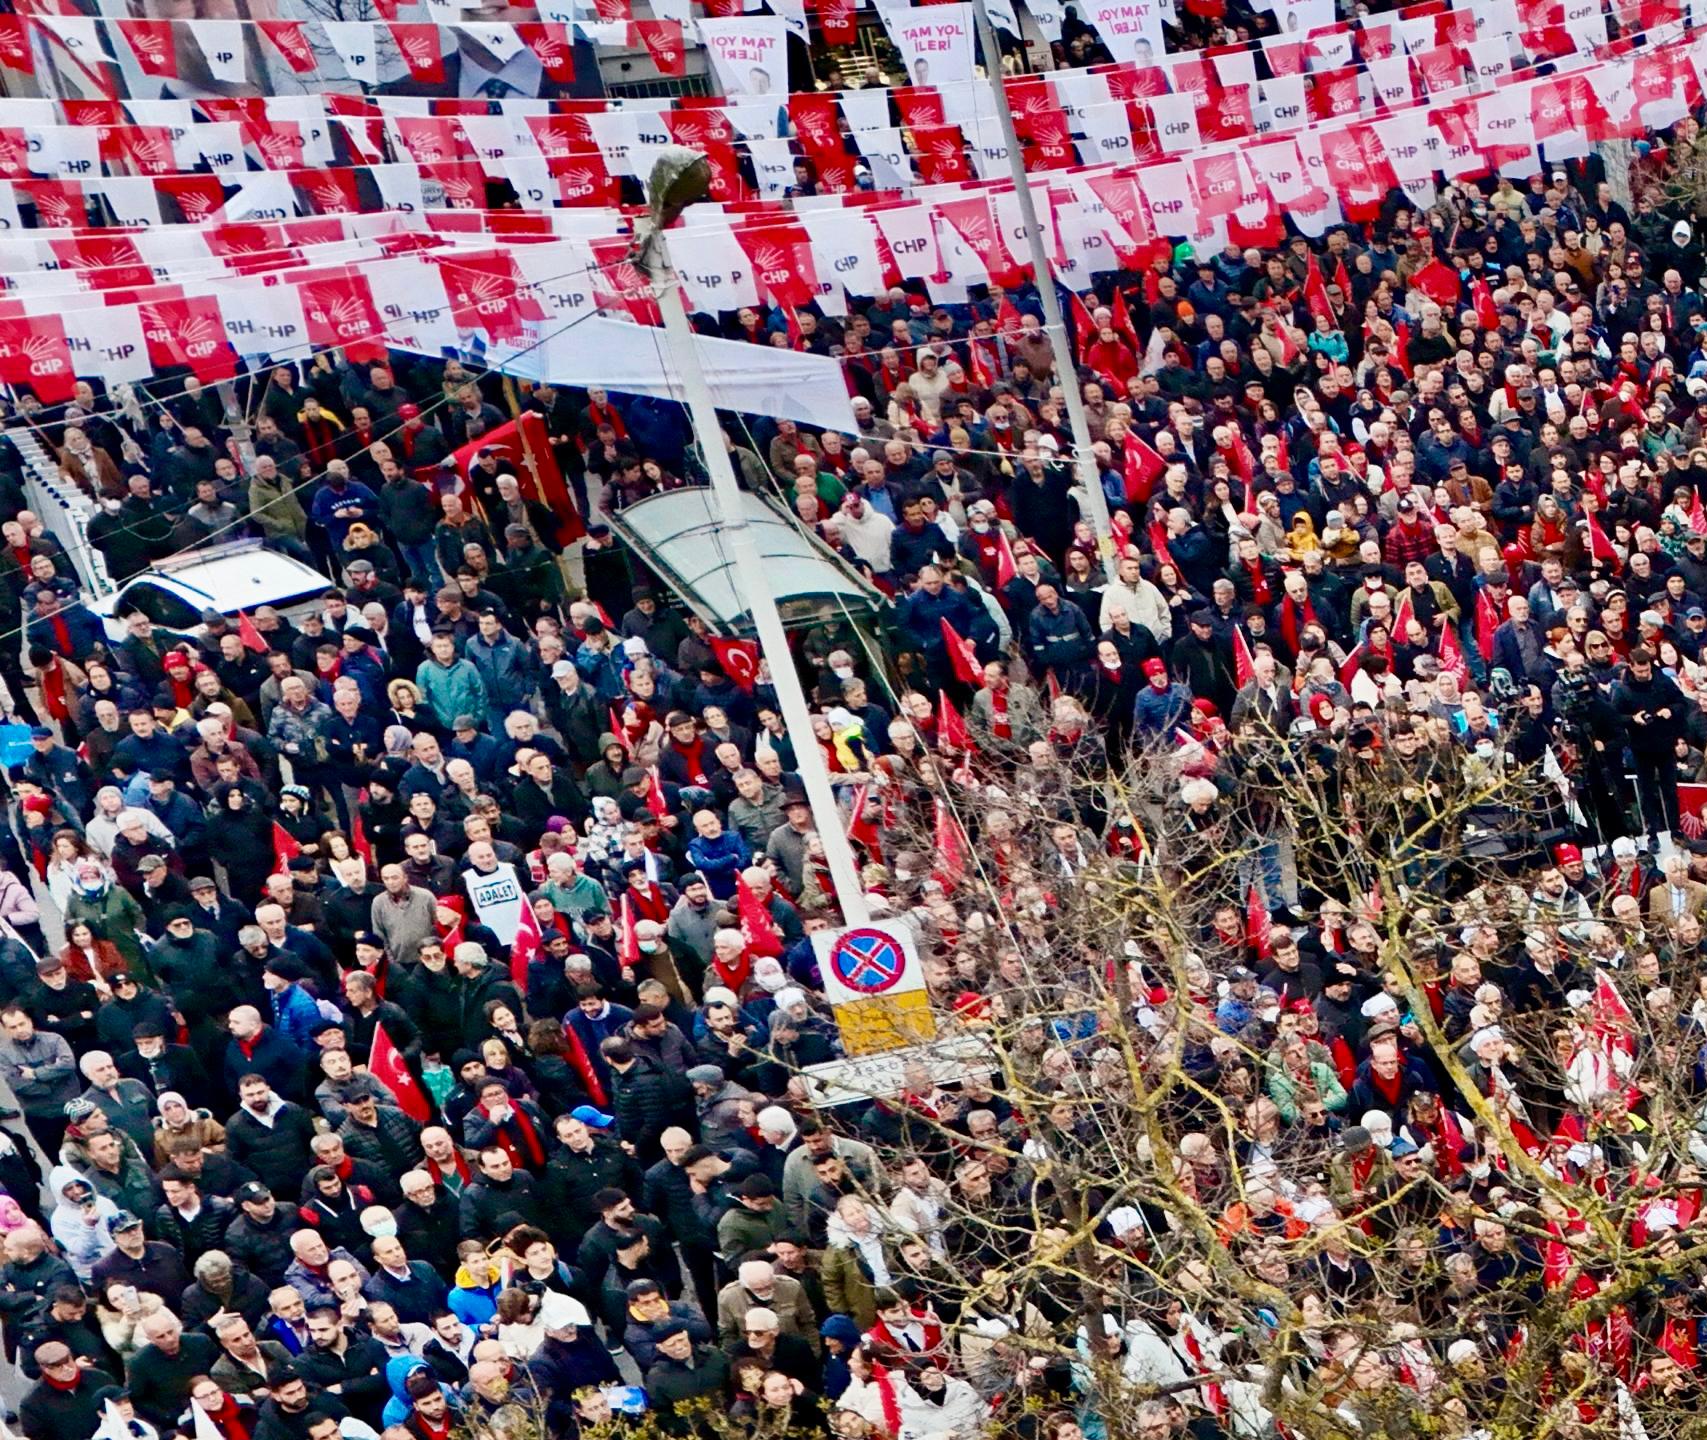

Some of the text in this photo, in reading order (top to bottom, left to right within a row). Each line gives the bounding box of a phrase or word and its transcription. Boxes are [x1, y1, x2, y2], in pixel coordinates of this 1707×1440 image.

[1569, 6, 1592, 20] CHP
[902, 24, 964, 41] TAM YOL
[914, 37, 951, 52] İLERİ
[1480, 62, 1504, 77] CHP
[1274, 105, 1300, 119] CHP
[1541, 105, 1566, 118] CHP
[1221, 115, 1245, 127] CHP
[1487, 118, 1517, 130] CHP
[1336, 159, 1364, 173] CHP
[1208, 175, 1236, 194] CHP
[1152, 200, 1183, 213] CHP
[893, 238, 928, 254] CHP
[761, 270, 790, 284] CHP
[337, 319, 371, 336] CHP
[186, 340, 218, 357] CHP
[30, 358, 64, 376] CHP
[479, 884, 513, 903] ADALET
